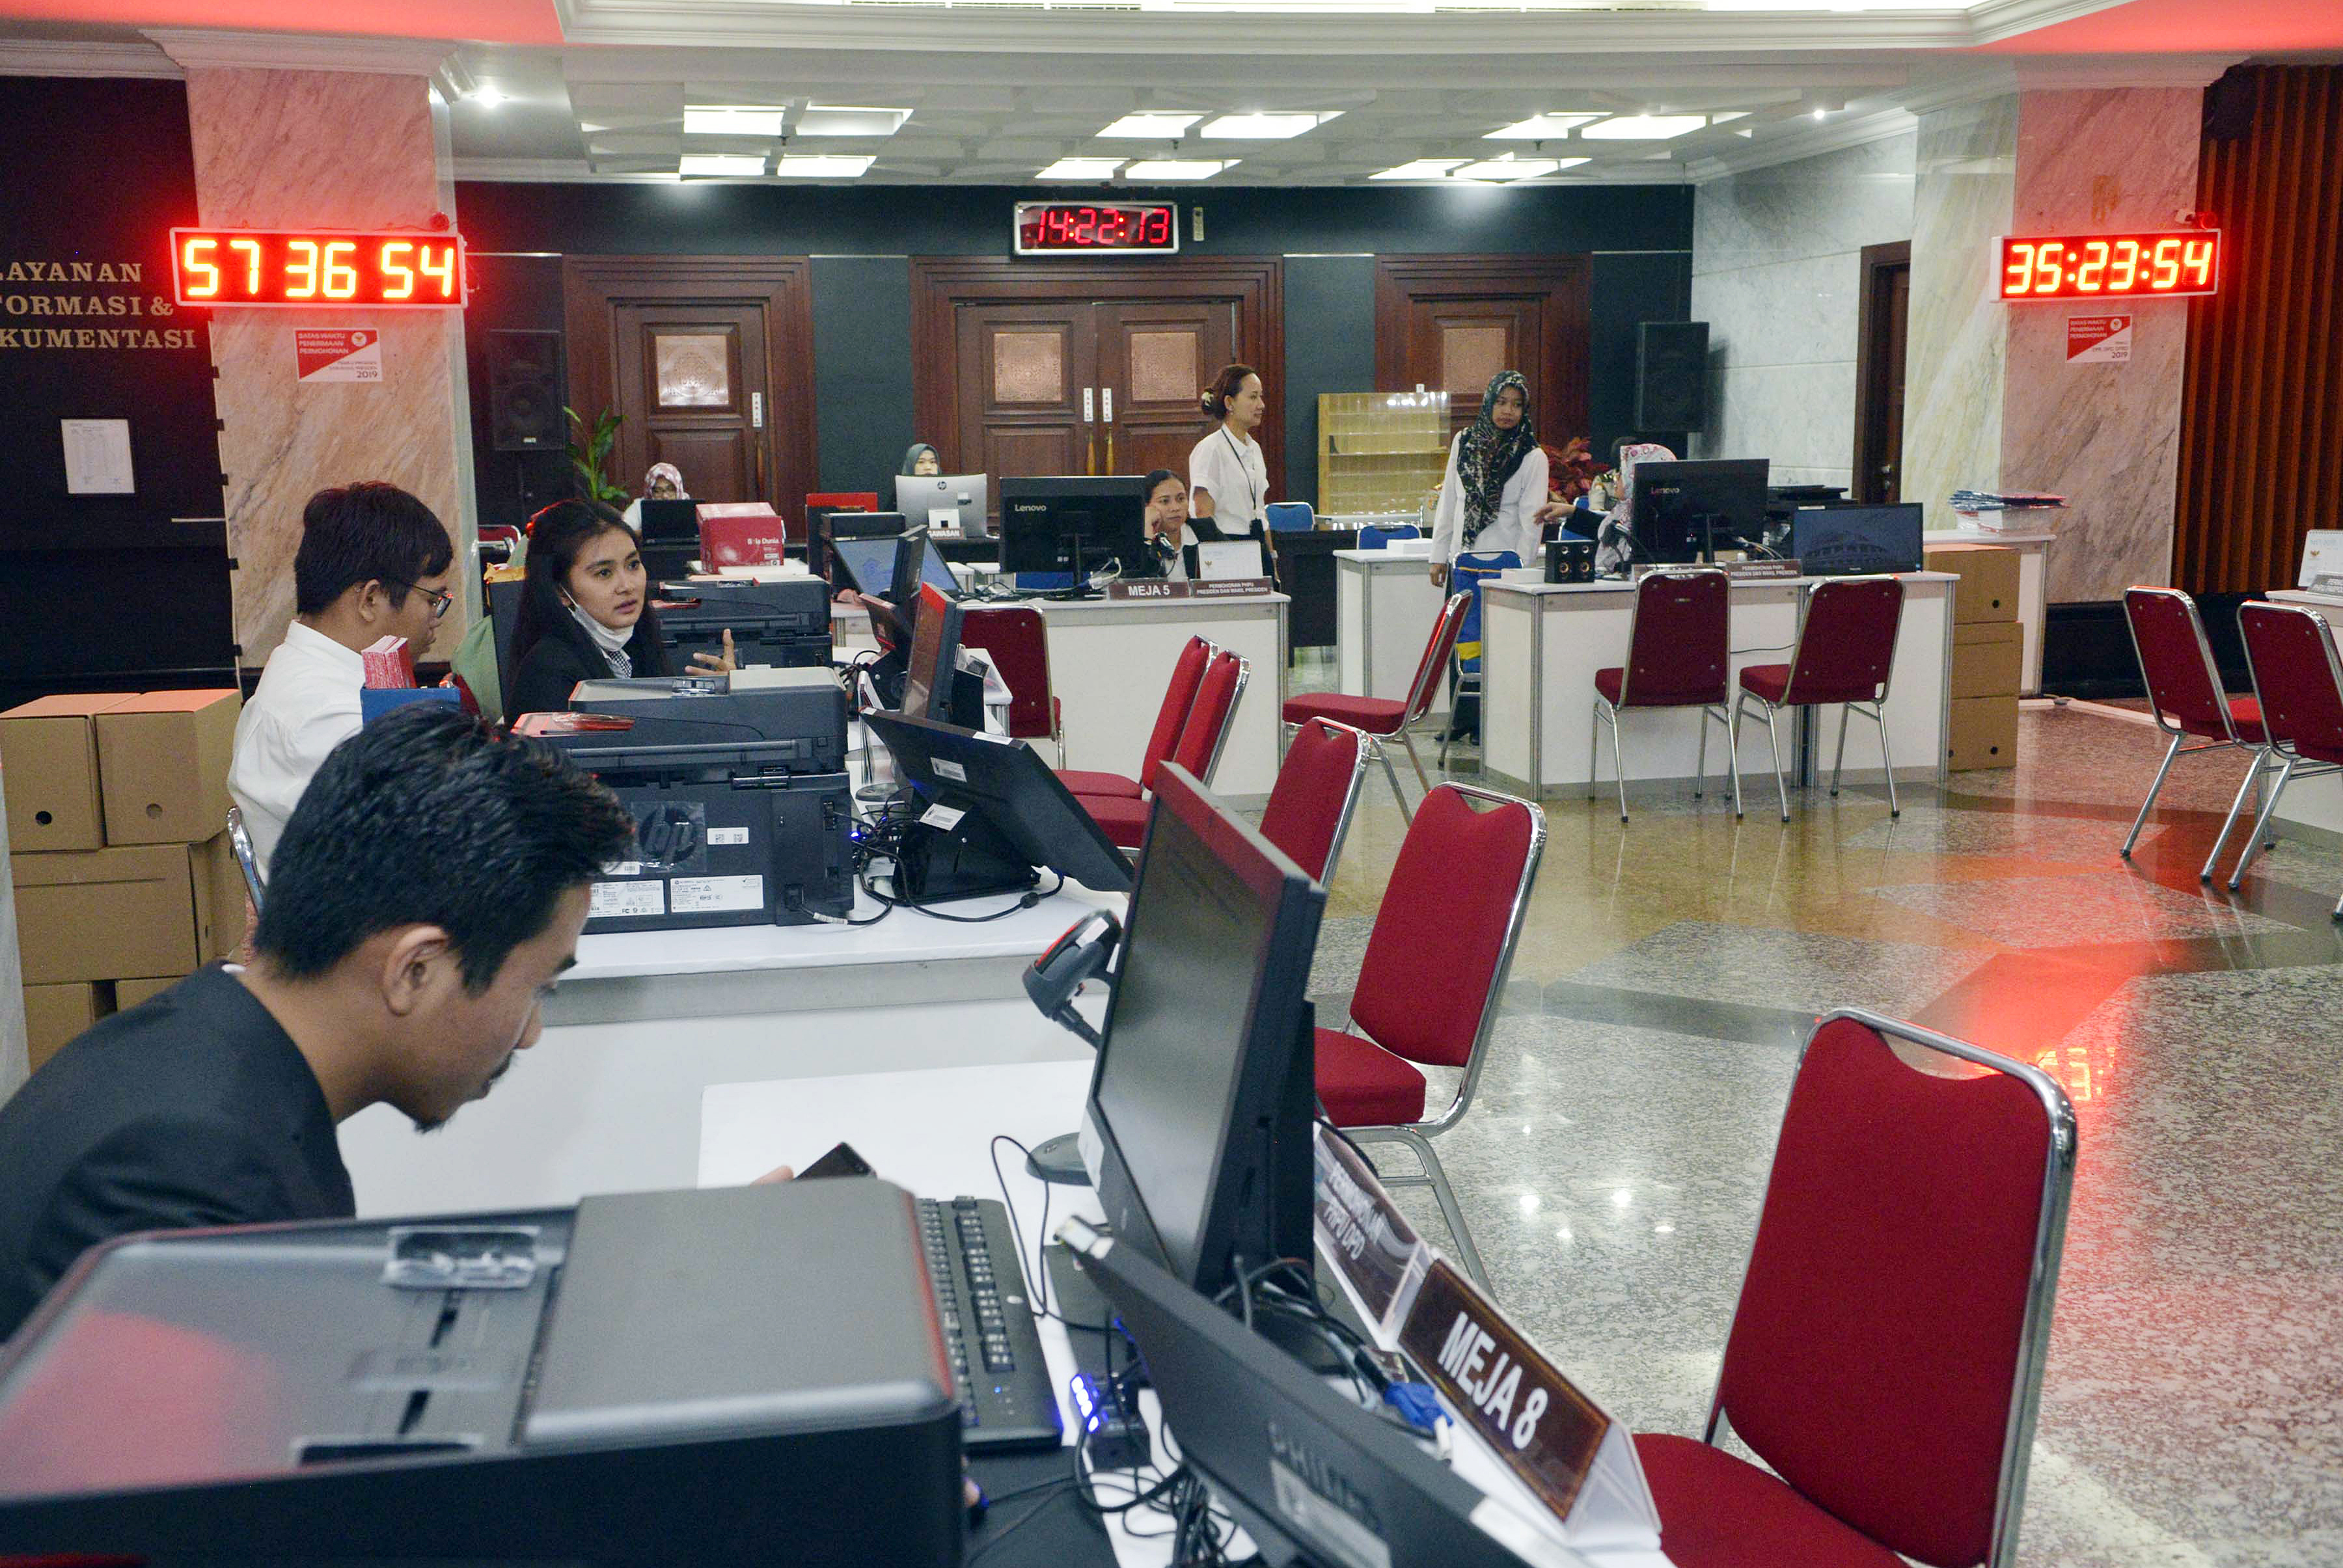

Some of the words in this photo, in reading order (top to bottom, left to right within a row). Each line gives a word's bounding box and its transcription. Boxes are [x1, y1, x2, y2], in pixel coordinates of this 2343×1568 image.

[1037, 208, 1170, 244] 14:22:13
[0, 262, 143, 282] AYANAN
[285, 241, 357, 298] 36
[381, 242, 455, 299] 54
[2005, 240, 2213, 294] 35:23:54
[0, 295, 143, 316] ORMASI
[150, 296, 174, 316] &
[1015, 504, 1047, 512] Lenovo
[1128, 585, 1160, 596] MEJA
[1163, 585, 1170, 596] 5
[1438, 1310, 1524, 1432] MEJA
[1512, 1387, 1548, 1450] 8
